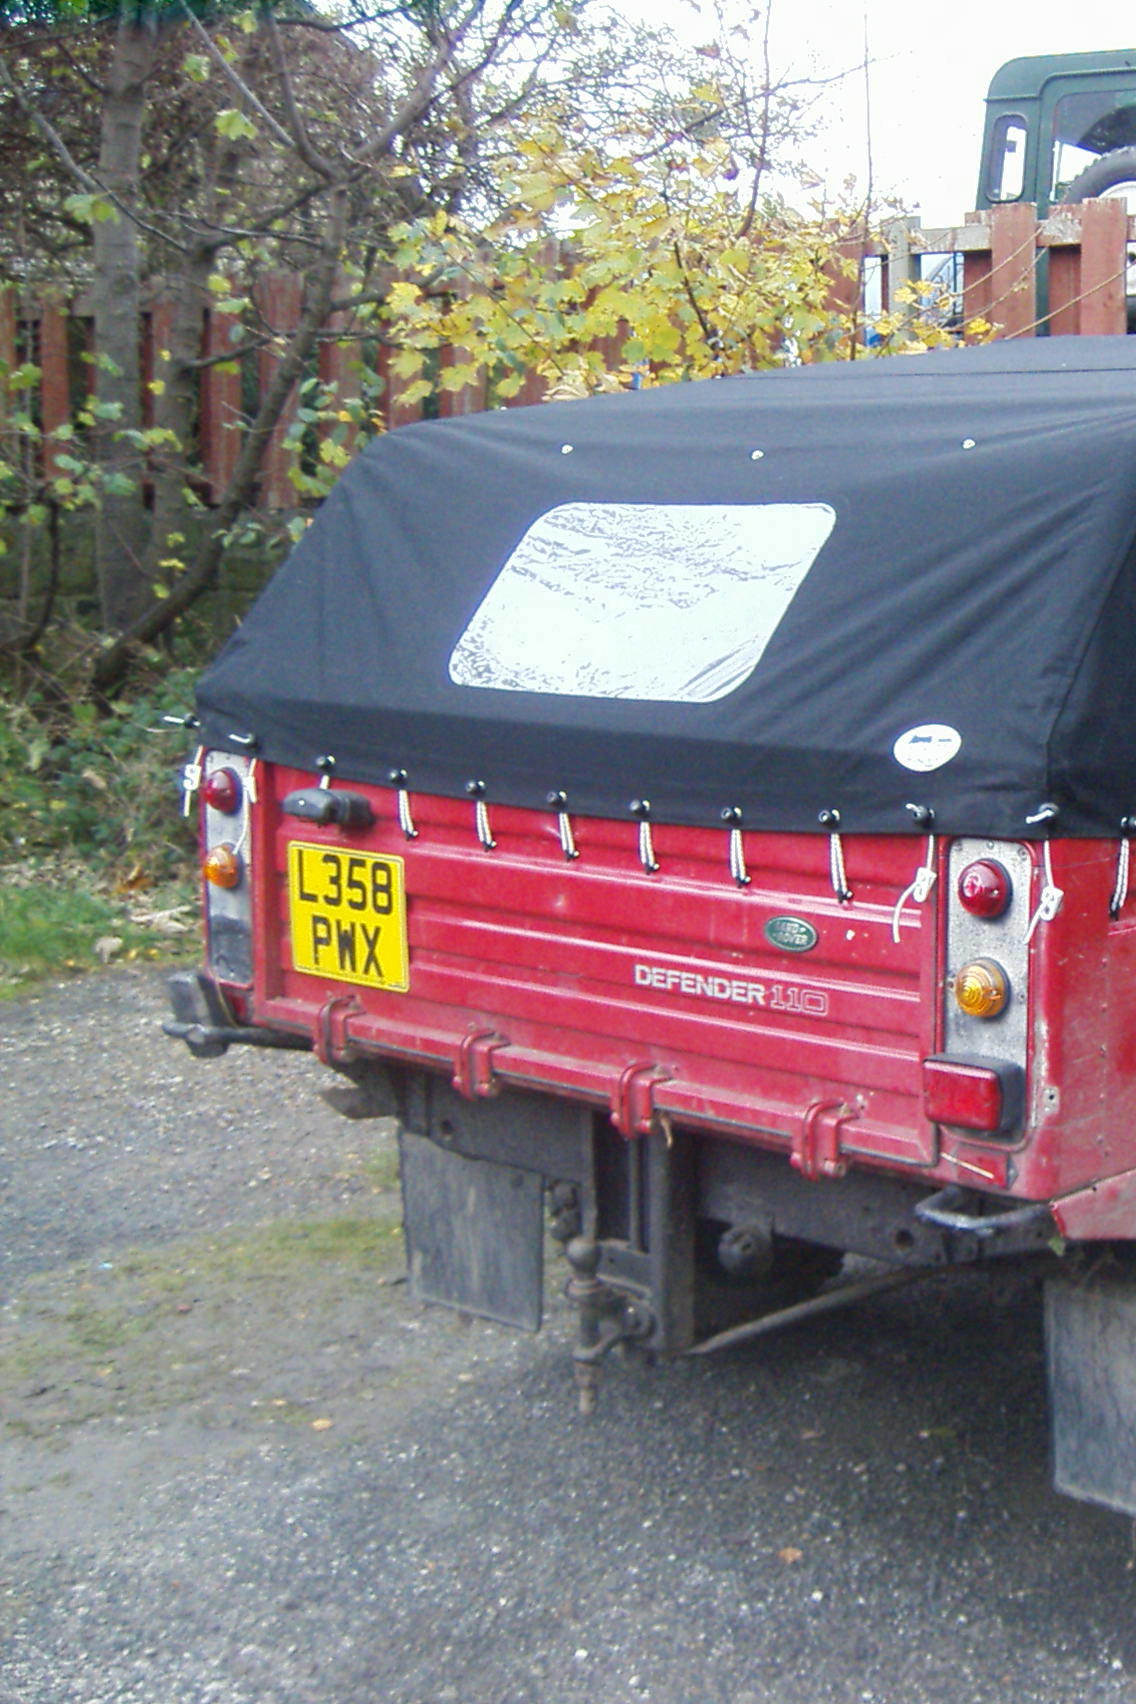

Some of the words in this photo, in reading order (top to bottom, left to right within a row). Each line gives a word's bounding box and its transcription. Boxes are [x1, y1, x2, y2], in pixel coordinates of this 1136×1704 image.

[298, 849, 392, 915] L358
[312, 914, 384, 977] PWX
[634, 964, 765, 1005] DEFENDER
[770, 984, 828, 1016] 110
